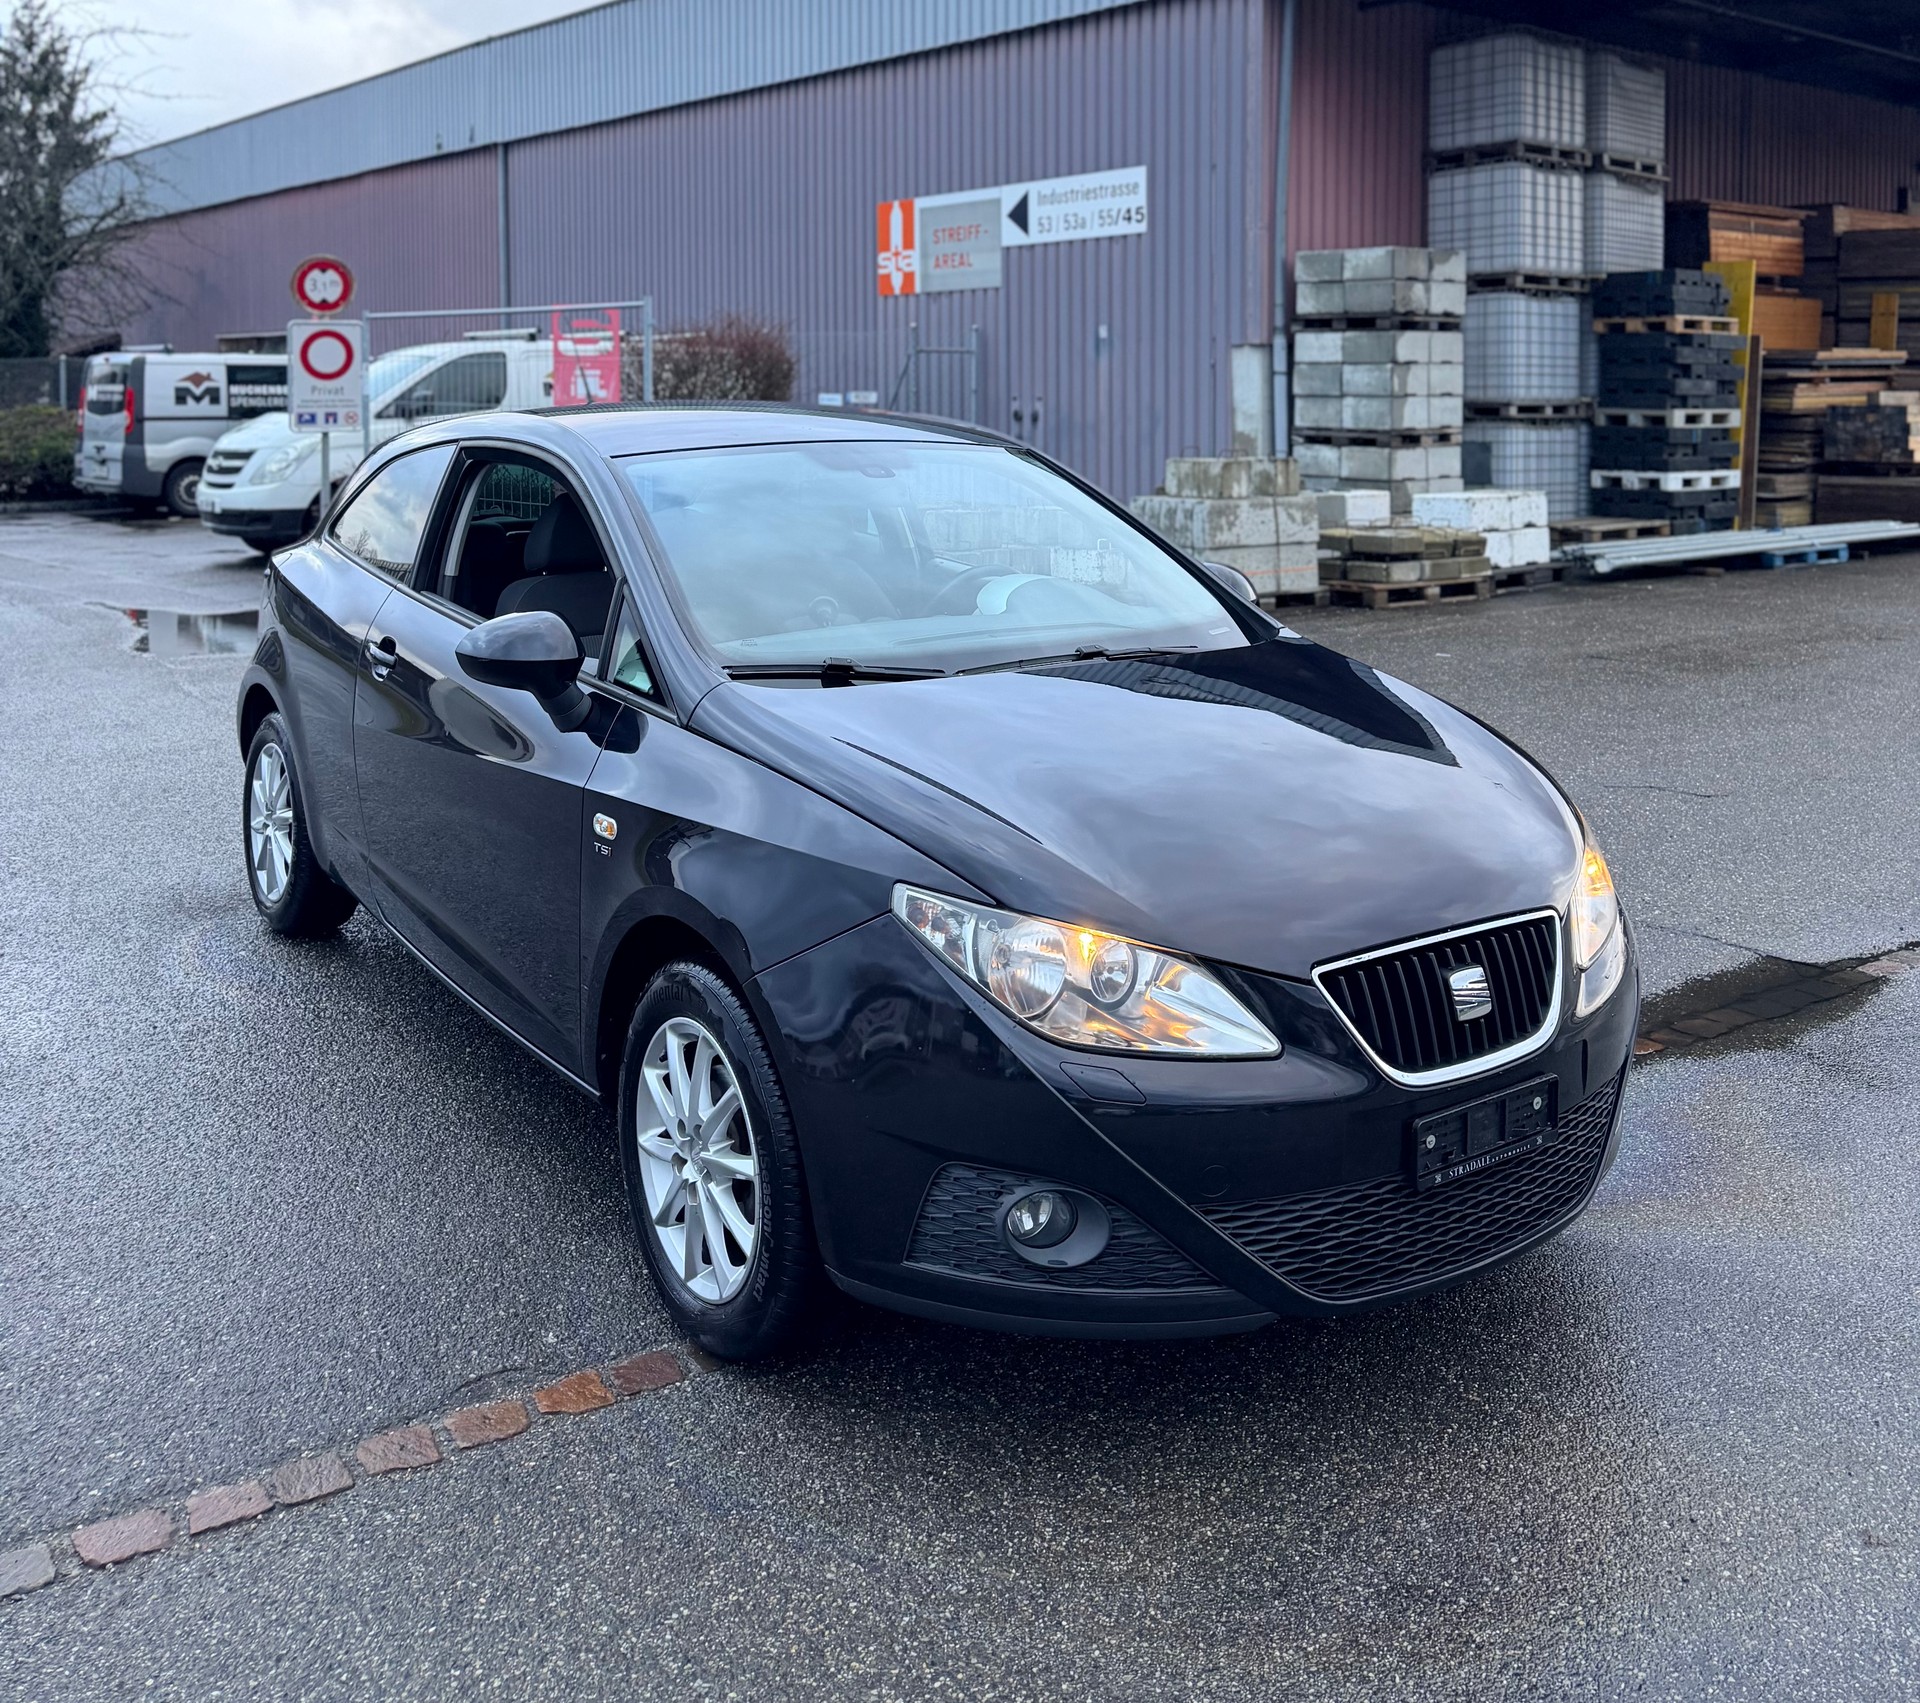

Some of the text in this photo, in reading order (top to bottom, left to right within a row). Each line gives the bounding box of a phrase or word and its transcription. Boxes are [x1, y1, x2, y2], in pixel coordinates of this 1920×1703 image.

[1037, 181, 1139, 206] Industriestrasse
[1038, 215, 1053, 234] 53
[1063, 212, 1087, 231] 53a
[932, 224, 989, 244] STREIFF-
[933, 252, 973, 269] AREAL
[310, 384, 345, 396] Privat
[1449, 1156, 1491, 1178] STRADALE
